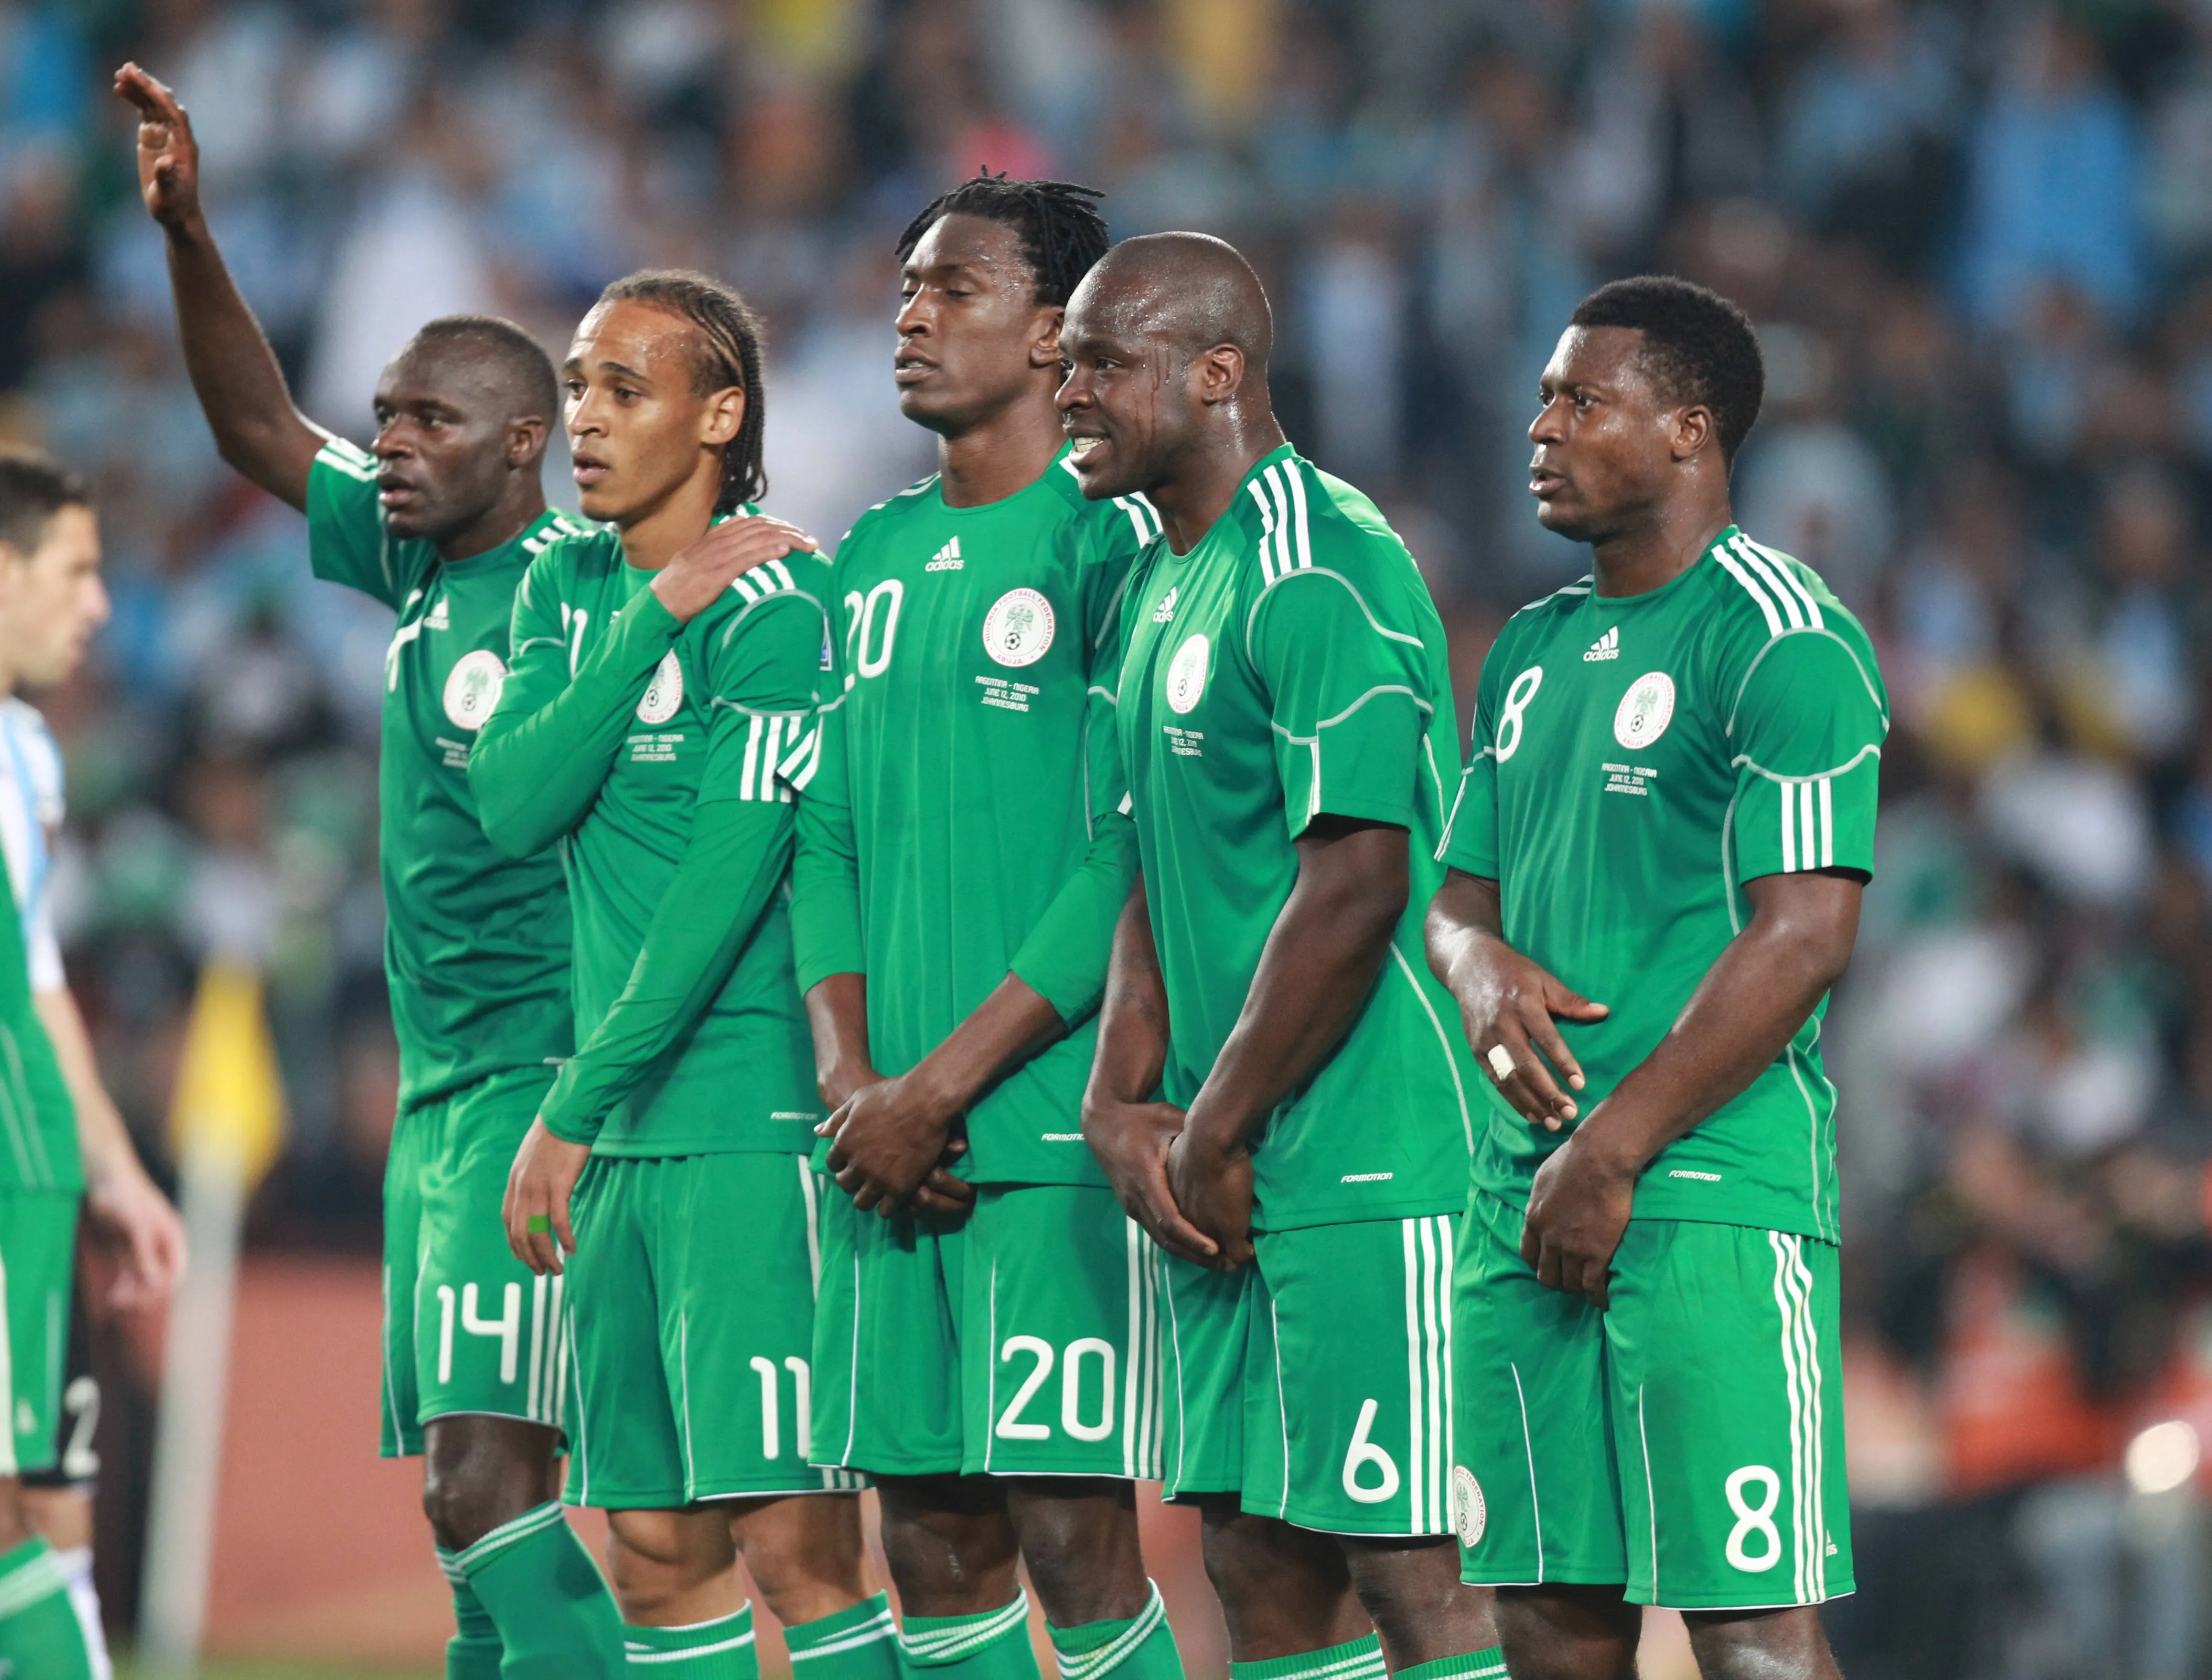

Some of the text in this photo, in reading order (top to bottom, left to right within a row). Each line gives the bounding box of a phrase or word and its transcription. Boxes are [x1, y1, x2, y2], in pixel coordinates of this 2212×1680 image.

[925, 558, 964, 572] adidas
[844, 579, 904, 692] 20
[985, 590, 1054, 651] NIGERIA FOOTBALL FEDERATION
[996, 654, 1023, 665] ABUJA
[1583, 648, 1620, 662] adidas
[984, 687, 1001, 697] JUNE
[1010, 692, 1027, 702] 2010
[1013, 682, 1040, 695] NIGERIA
[1496, 665, 1543, 764] 8
[1623, 738, 1643, 747] ABUJA
[1340, 1172, 1393, 1183] FORMOTION
[1668, 1169, 1722, 1182] FORMOTION
[437, 1281, 521, 1384] 14
[749, 1355, 810, 1460] 11
[995, 1335, 1116, 1441] 20
[1342, 1398, 1400, 1504] 6
[1466, 1472, 1485, 1526] FEDERATION
[1725, 1464, 1781, 1573] 8
